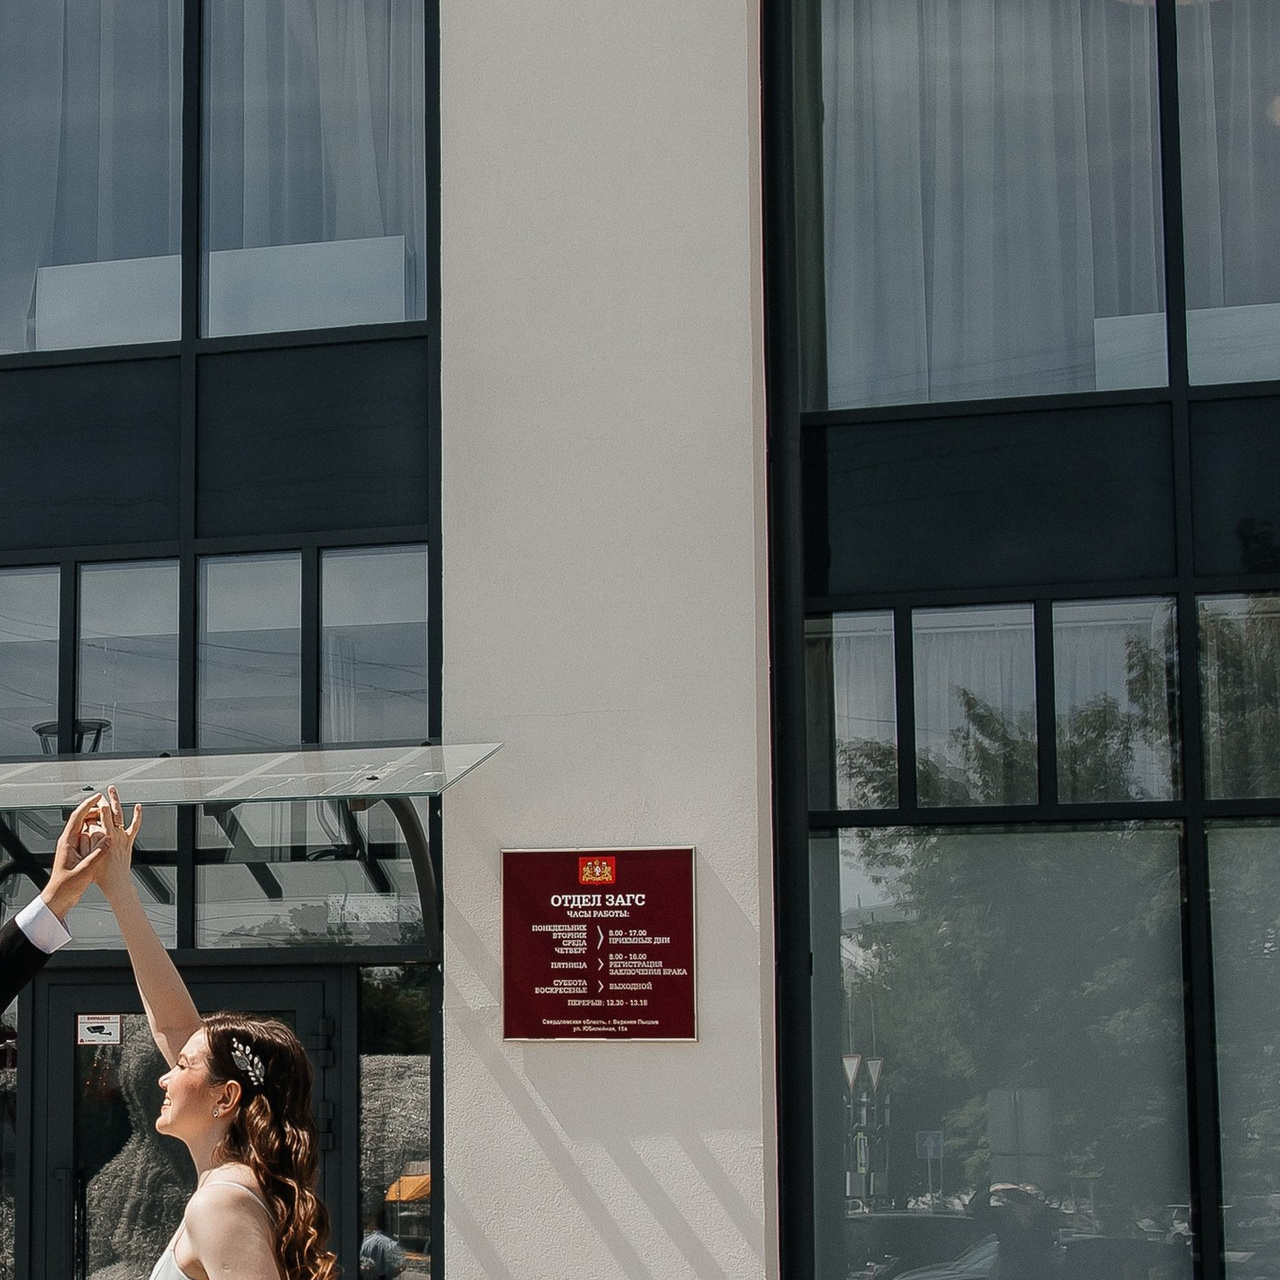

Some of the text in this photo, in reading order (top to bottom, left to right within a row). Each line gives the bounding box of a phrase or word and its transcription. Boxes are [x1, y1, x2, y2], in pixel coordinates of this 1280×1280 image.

[550, 894, 645, 908] ОТДЕЛ ЗАГС
[566, 910, 630, 918] ЧАСЫ РАБОТЫ:
